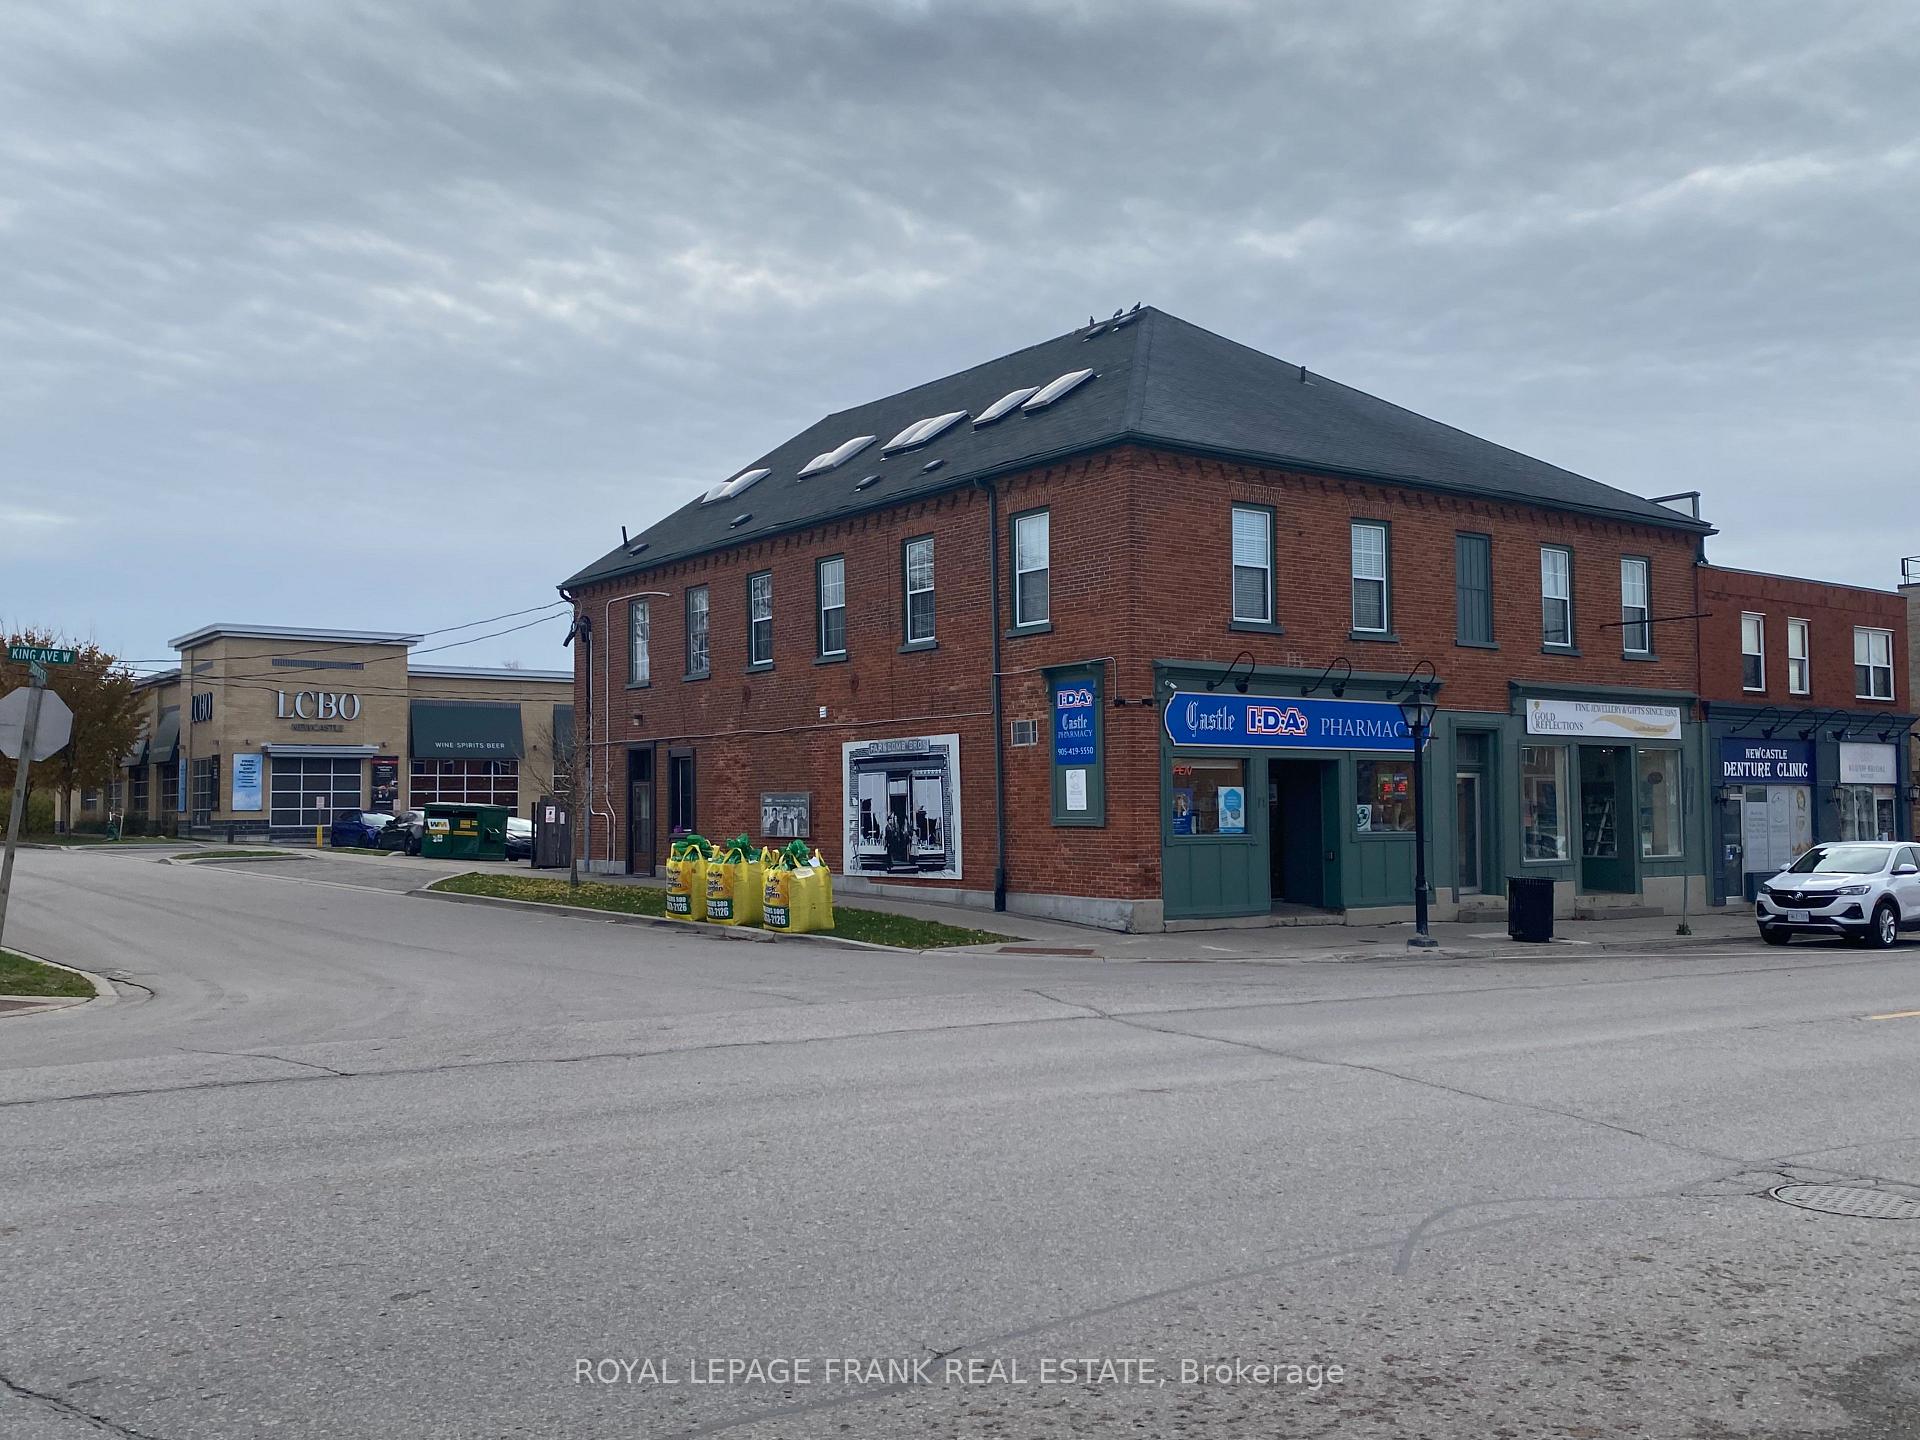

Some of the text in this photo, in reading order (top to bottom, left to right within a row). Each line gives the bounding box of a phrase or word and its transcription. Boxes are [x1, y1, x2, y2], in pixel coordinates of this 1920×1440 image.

[12, 648, 70, 662] KING AVE W
[277, 690, 361, 720] LCBO
[1576, 703, 1590, 712] FINE
[1628, 706, 1646, 715] GIFTS
[1646, 707, 1664, 716] SINCE
[1062, 713, 1088, 730] Castle
[1185, 701, 1236, 737] Castle
[1320, 717, 1414, 738] PHARMAC
[1535, 711, 1556, 721] GOLD
[1536, 720, 1584, 731] REFLECTIONS
[1058, 729, 1093, 739] PHARMACY
[1057, 746, 1094, 756] 905-419-5550
[1745, 747, 1788, 760] NEWCASTLE
[1723, 761, 1809, 778] DENTURE CLINIC
